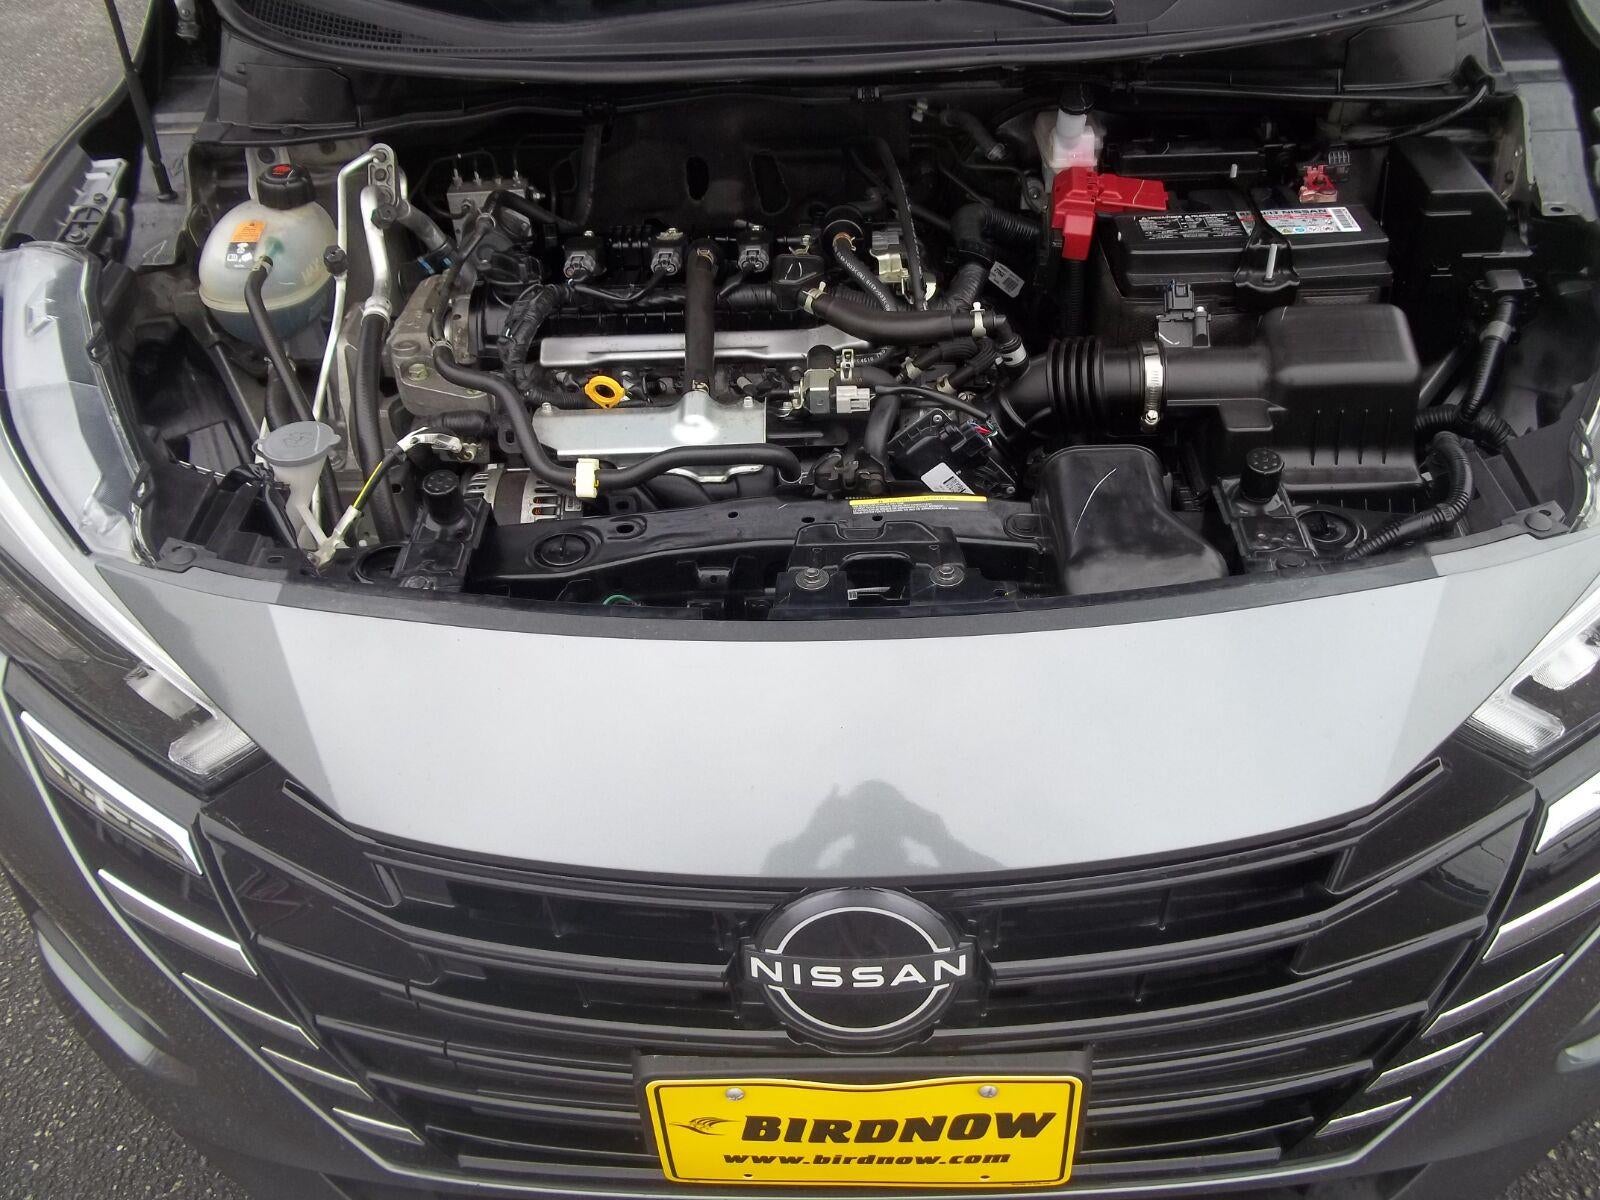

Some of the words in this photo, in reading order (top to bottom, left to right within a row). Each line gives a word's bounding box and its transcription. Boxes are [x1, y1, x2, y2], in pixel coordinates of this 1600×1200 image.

[750, 954, 967, 988] NISSAN
[740, 1111, 1058, 1144] BIRDNOW
[723, 1152, 1012, 1166] www.birdnow.com
